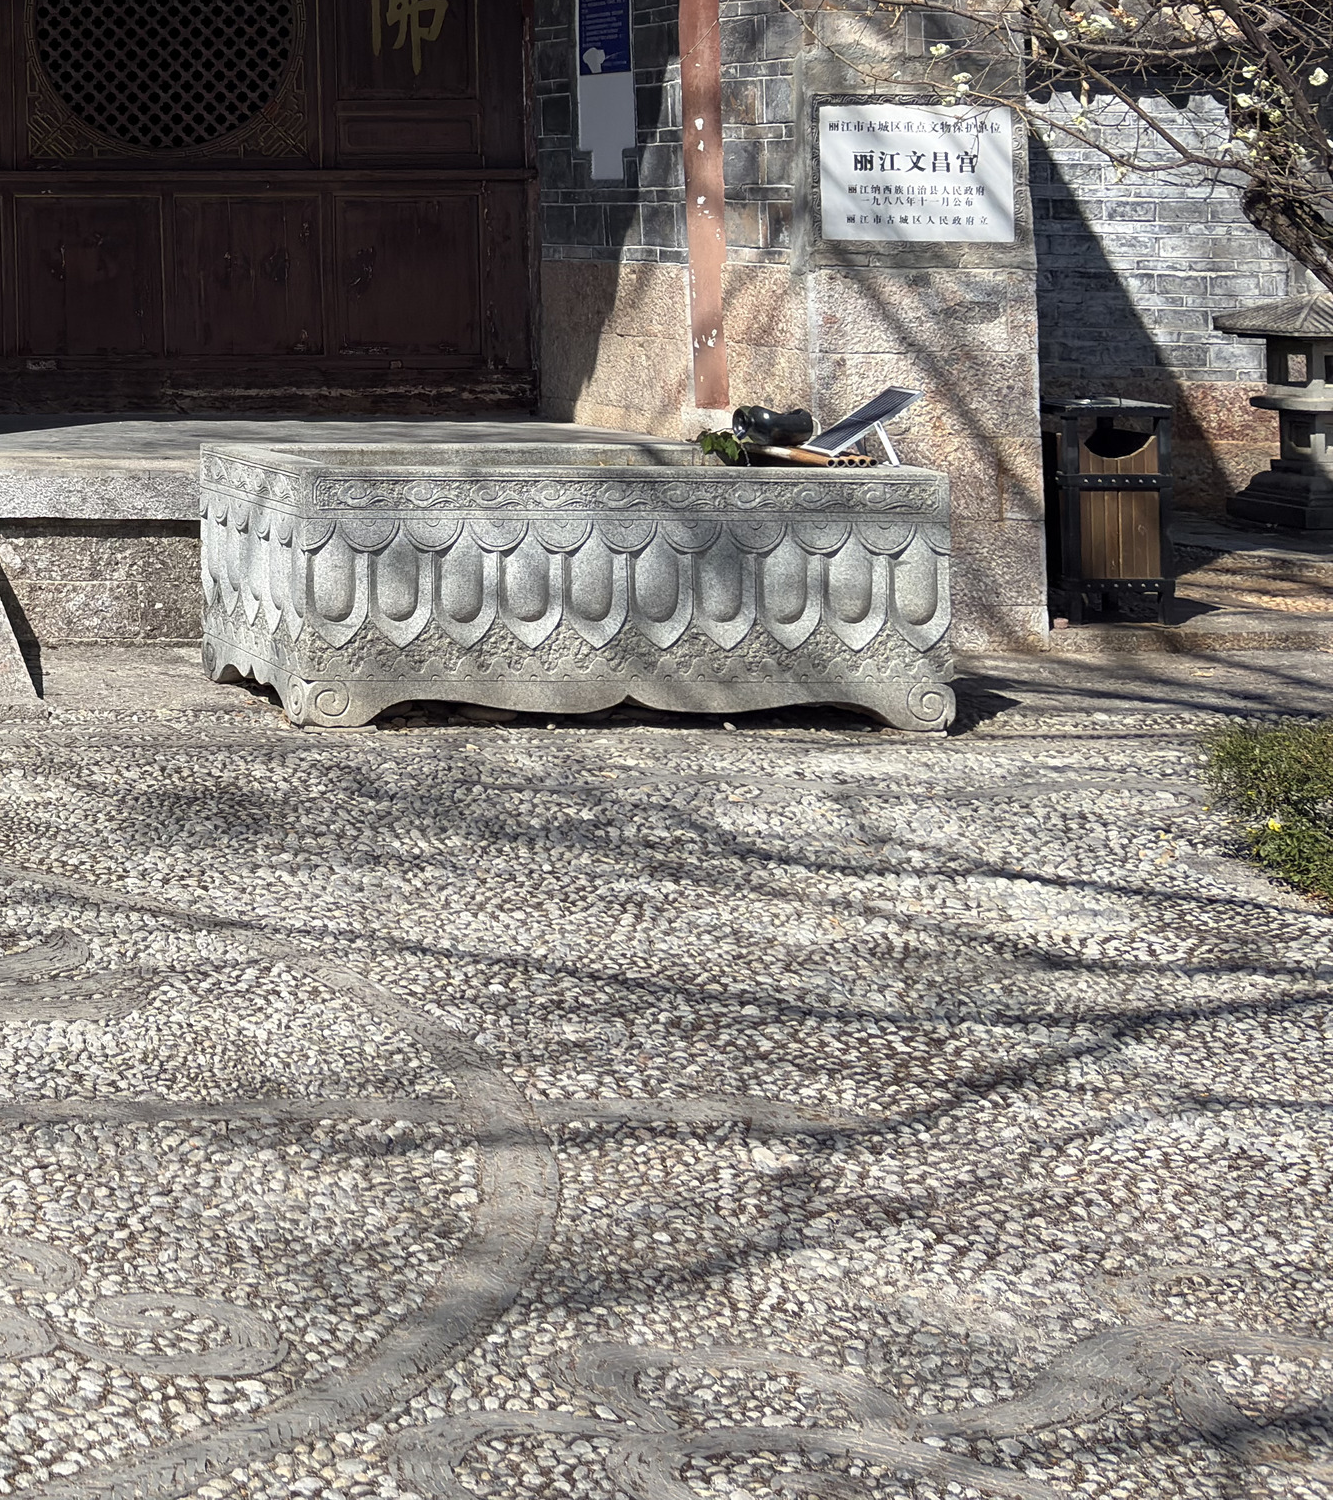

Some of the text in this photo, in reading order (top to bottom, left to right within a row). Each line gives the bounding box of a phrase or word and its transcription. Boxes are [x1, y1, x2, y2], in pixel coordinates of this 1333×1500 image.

[828, 120, 1002, 134] 丽江市古城区重点文物保护单位
[852, 150, 978, 174] 丽江文昌宫
[848, 184, 985, 196] 丽江纳西族自治县人民政府
[861, 196, 974, 207] 一九八八年十一月公布
[846, 214, 989, 226] 丽江市古城区人民政府立
